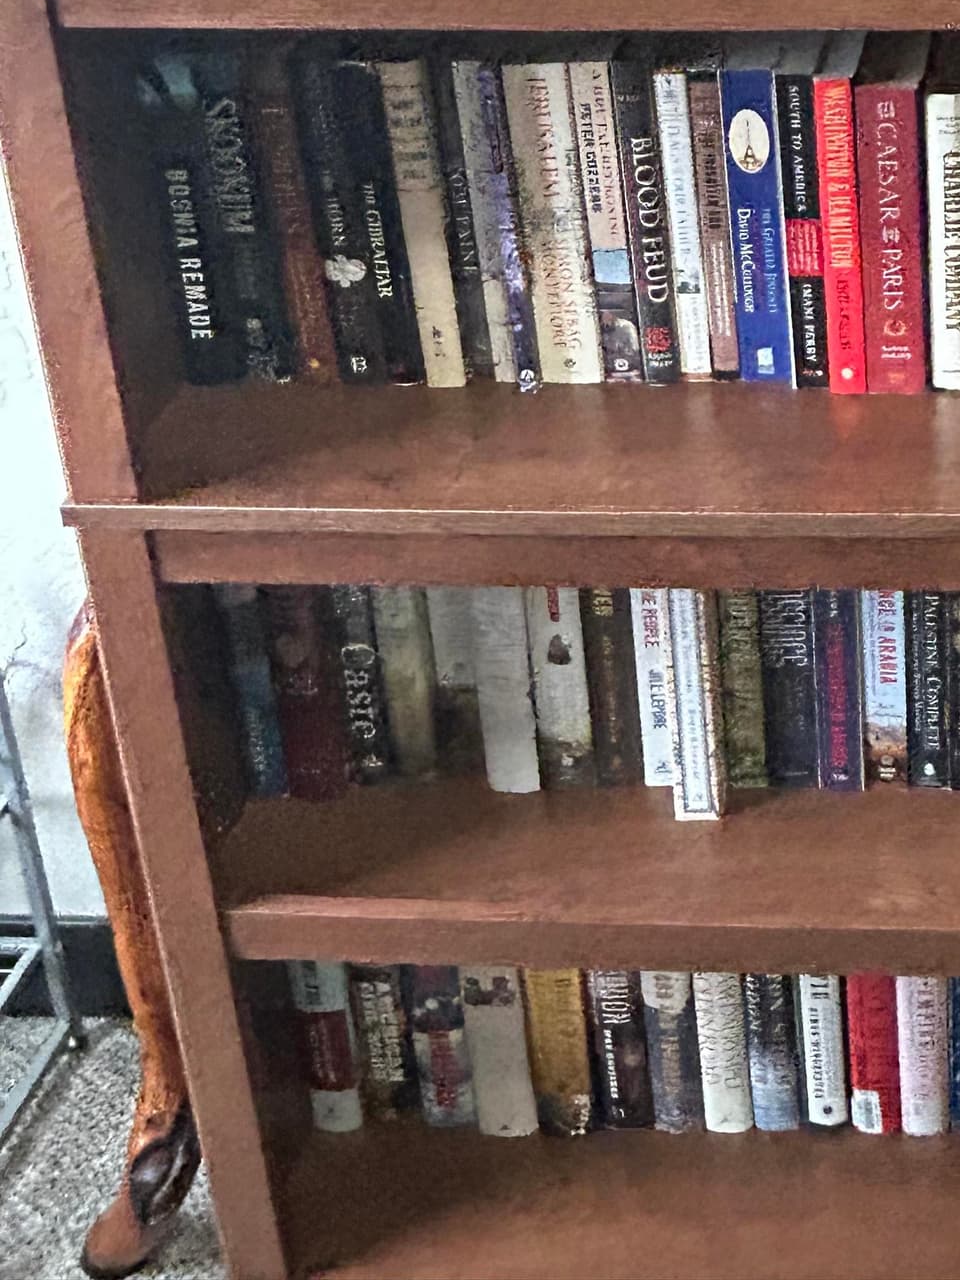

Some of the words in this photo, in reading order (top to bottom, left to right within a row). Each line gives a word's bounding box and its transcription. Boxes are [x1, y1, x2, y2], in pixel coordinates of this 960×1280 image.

[526, 77, 561, 199] JERUSALEM
[578, 103, 596, 148] PETER
[788, 84, 802, 128] SOUTH
[791, 132, 803, 150] TO
[820, 84, 852, 177] WASHINGTON
[164, 169, 198, 248] BOSNIA
[631, 137, 660, 228] BLOOD
[792, 154, 807, 213] AMERICA
[874, 122, 899, 224] CAESAR
[366, 210, 393, 298] GIBRALTAR
[828, 195, 854, 268] HAMILTON
[179, 258, 214, 340] REMADE
[642, 238, 669, 303] FEUD
[882, 248, 905, 311] PARIS
[802, 323, 818, 363] PERRY
[341, 643, 377, 738] Caste
